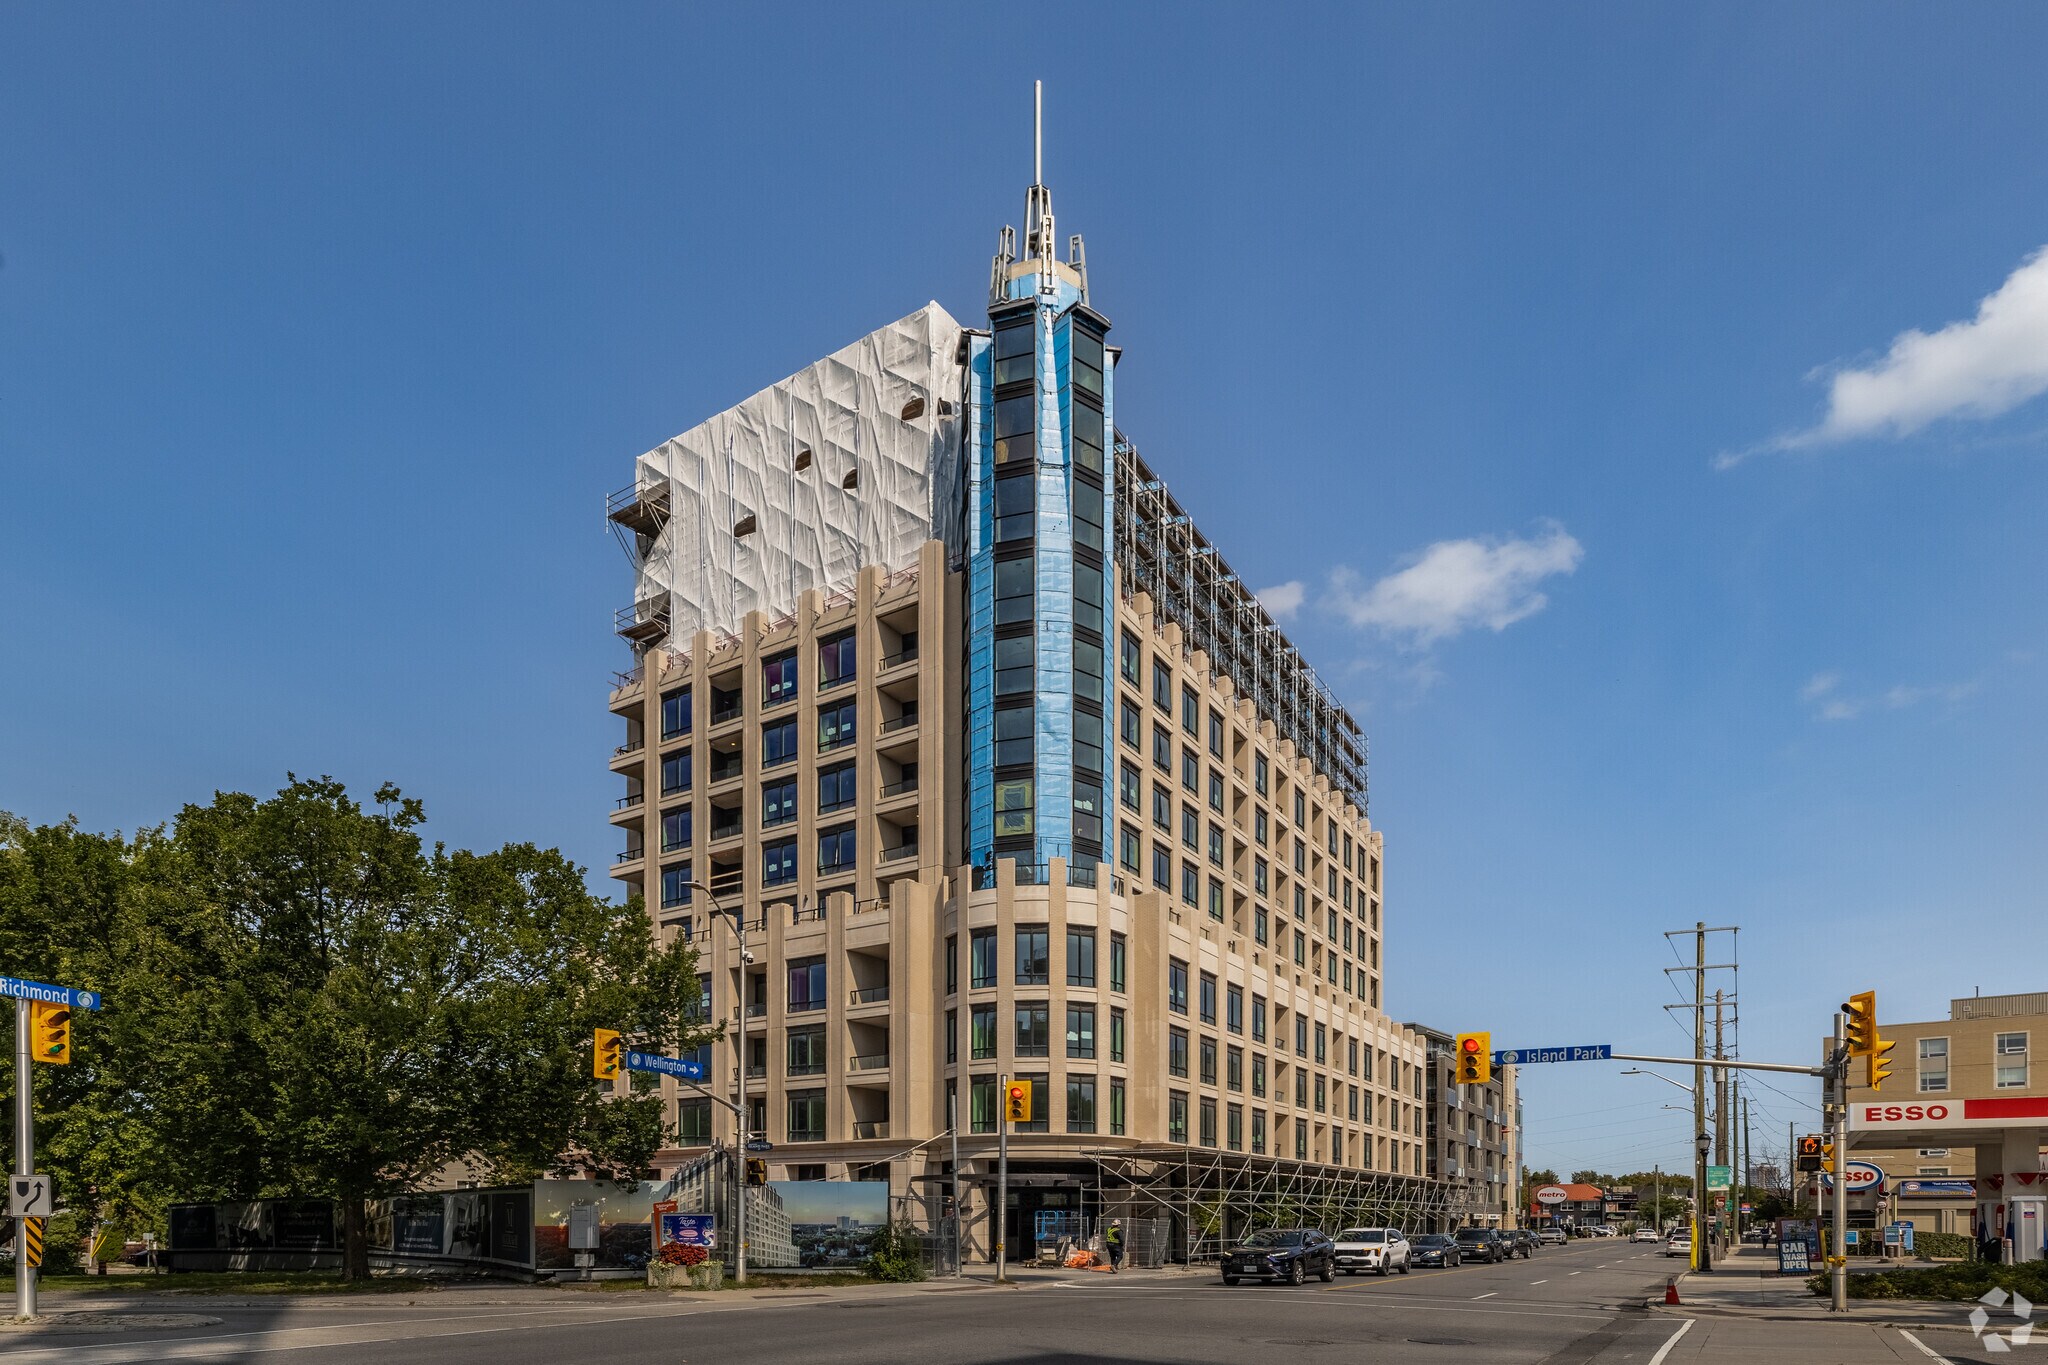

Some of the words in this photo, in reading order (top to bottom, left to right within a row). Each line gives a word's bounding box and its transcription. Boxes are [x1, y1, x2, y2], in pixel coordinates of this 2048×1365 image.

[0, 977, 69, 1004] Richmond
[1526, 1048, 1567, 1063] Island
[1574, 1046, 1604, 1060] Park
[644, 1055, 687, 1073] Wellington
[1866, 1105, 1949, 1121] ESSO
[1781, 1242, 1807, 1253] CAR
[1782, 1252, 1808, 1261] WASH
[1783, 1260, 1809, 1270] OPEN
